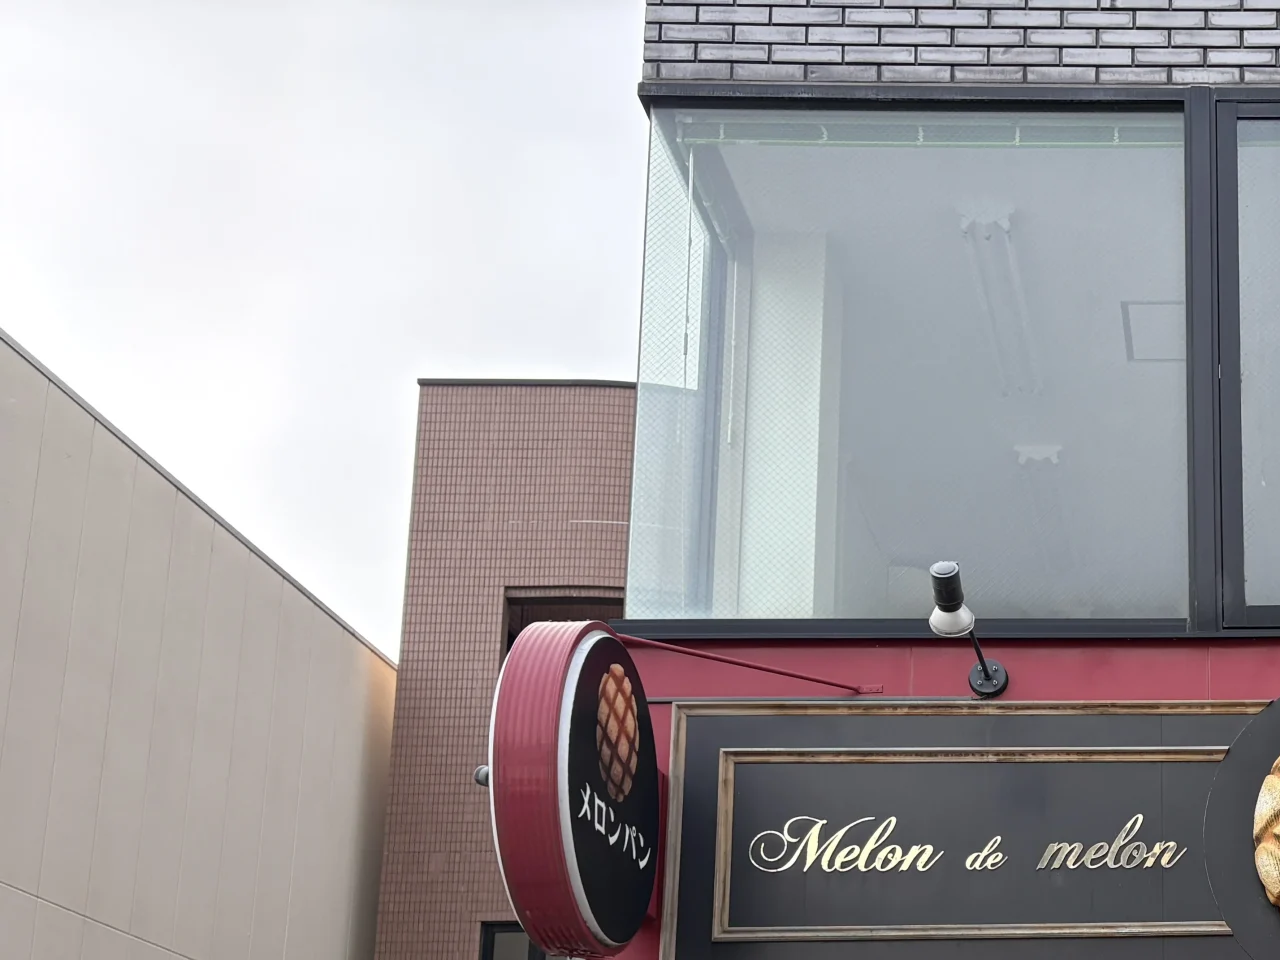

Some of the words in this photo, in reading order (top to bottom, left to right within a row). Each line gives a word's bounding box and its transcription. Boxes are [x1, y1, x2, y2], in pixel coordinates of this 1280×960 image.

[577, 782, 652, 870] メロンパン
[749, 815, 944, 873] Melon
[965, 836, 1008, 871] de
[1036, 813, 1188, 871] melon
